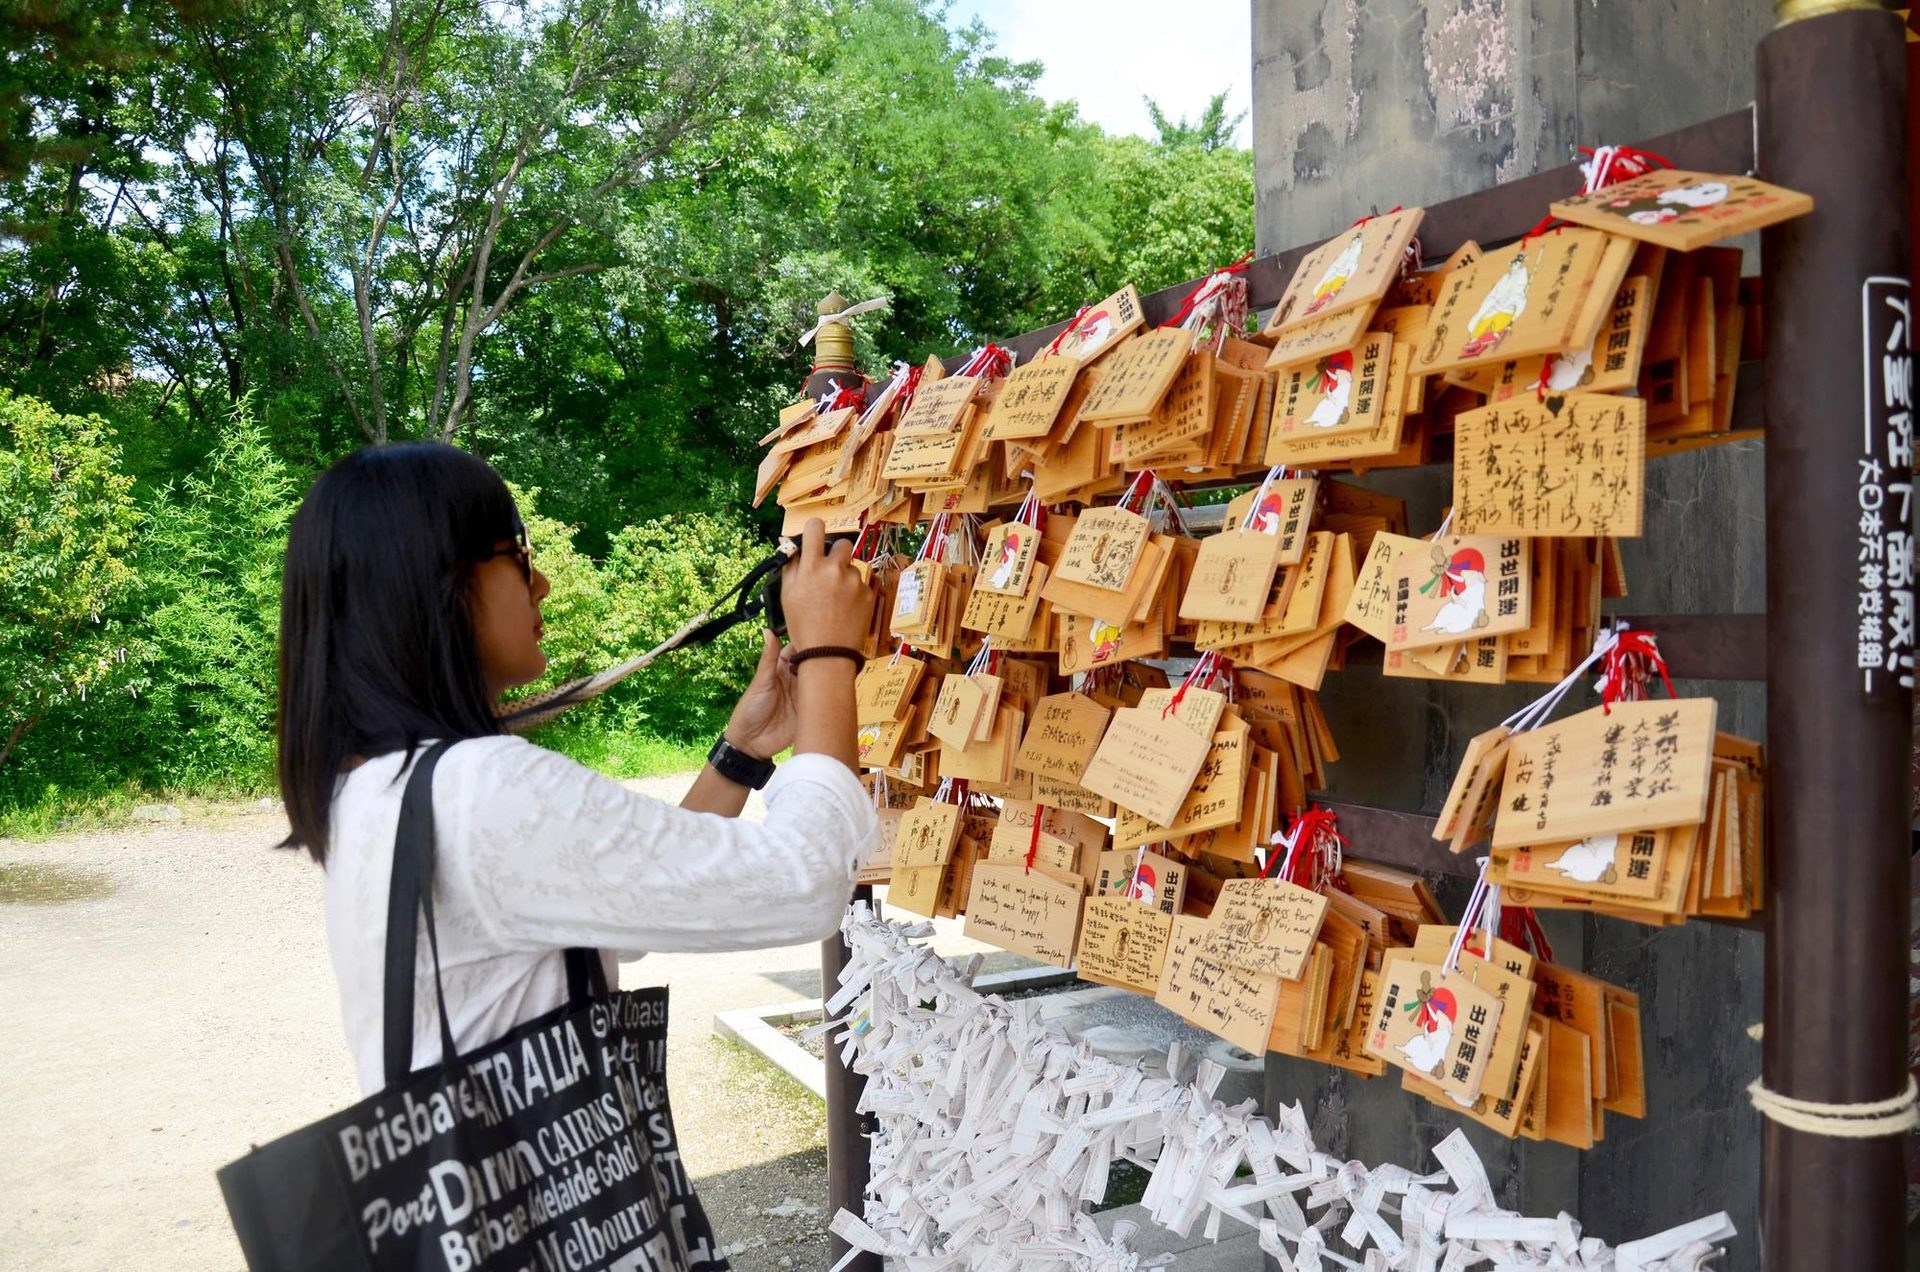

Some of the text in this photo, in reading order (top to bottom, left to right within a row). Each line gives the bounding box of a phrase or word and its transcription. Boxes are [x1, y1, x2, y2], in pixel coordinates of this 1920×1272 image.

[1355, 342, 1380, 415] 出世開運
[1281, 487, 1306, 551] 出世開運
[1498, 538, 1521, 617] 出世開運
[1451, 1004, 1487, 1084] 出世開運
[362, 1182, 438, 1255] Port
[536, 1091, 625, 1168] CAIRNS
[594, 1134, 640, 1189] Gold
